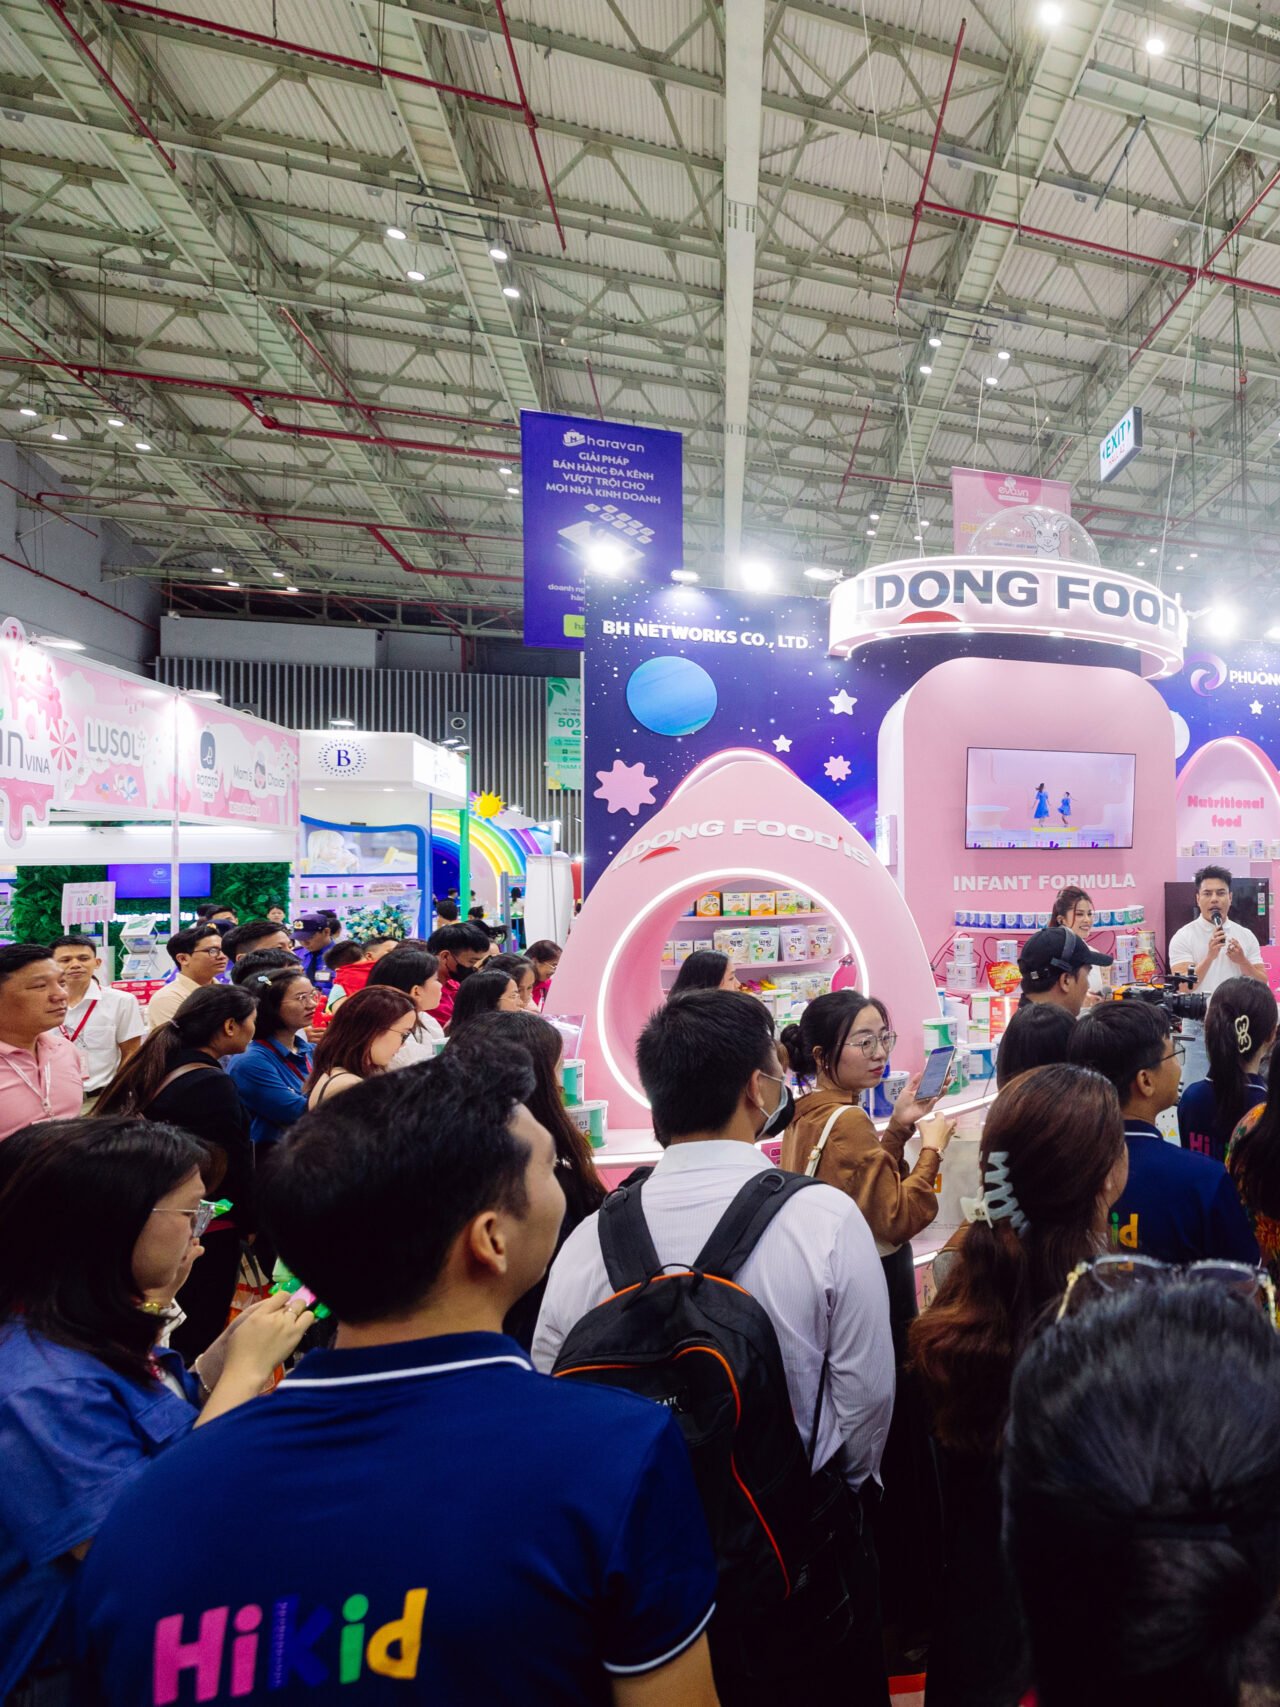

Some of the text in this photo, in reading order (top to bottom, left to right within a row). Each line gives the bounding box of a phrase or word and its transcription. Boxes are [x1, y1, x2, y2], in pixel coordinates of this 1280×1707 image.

[587, 433, 645, 453] haravan
[1105, 421, 1126, 459] EXIT
[622, 480, 645, 491] CHO
[595, 488, 621, 500] KINH
[622, 492, 661, 505] DOANH
[602, 620, 630, 635] BH
[634, 622, 737, 645] NETWORKS
[741, 632, 774, 648] CO.,
[87, 722, 140, 761] LUSOL
[25, 754, 51, 775] VINA
[337, 749, 350, 767] B
[1187, 795, 1264, 809] Nutritional
[1212, 814, 1242, 828] food
[612, 820, 725, 871] ILDONG
[953, 873, 1136, 892] INFANT FORMULA
[153, 1588, 428, 1706] Hikid
